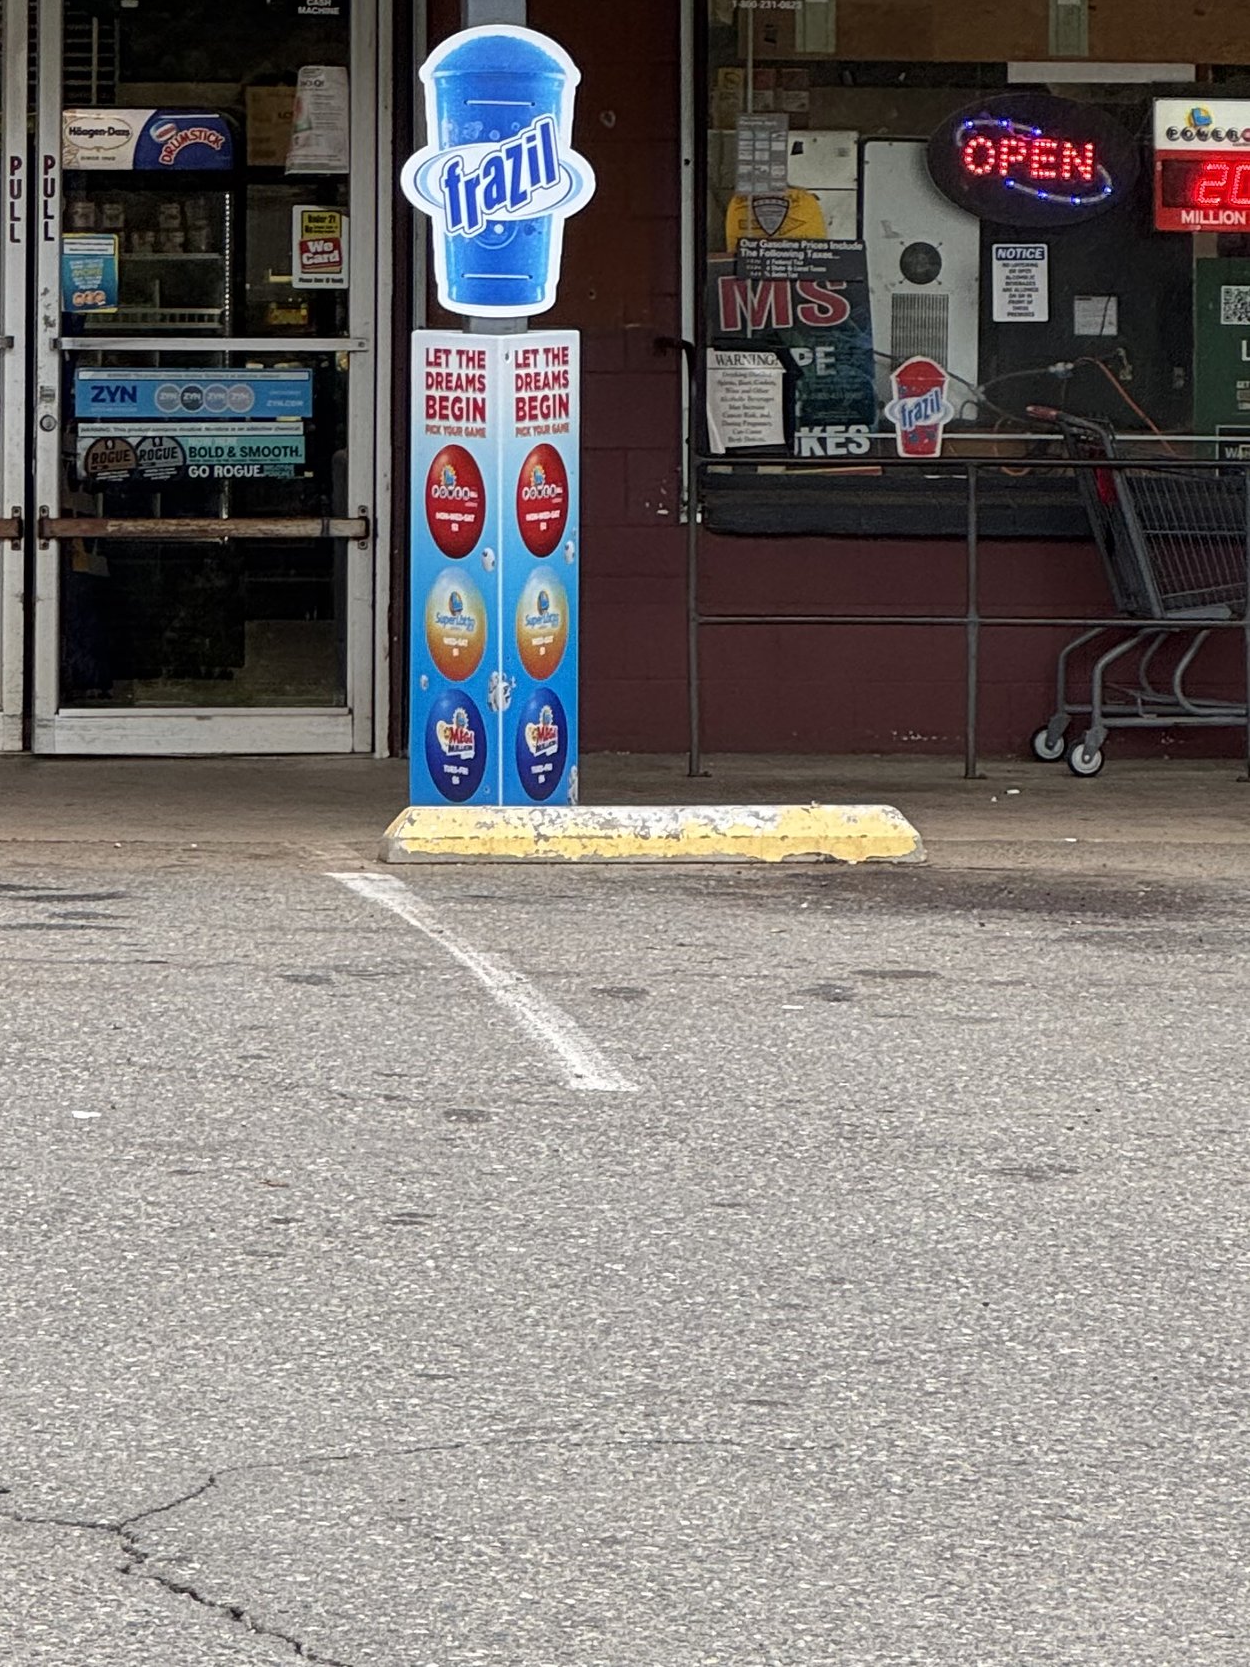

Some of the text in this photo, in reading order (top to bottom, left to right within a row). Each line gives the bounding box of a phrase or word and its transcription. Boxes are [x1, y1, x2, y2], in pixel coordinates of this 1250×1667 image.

[297, 6, 340, 15] MACHINE
[158, 127, 225, 165] DRUMSTICK
[964, 135, 1094, 181] OPEN
[443, 119, 558, 233] frazil
[9, 155, 23, 244] PULL
[42, 154, 56, 242] PULL
[1181, 209, 1246, 225] MILLION
[306, 240, 334, 253] We
[739, 239, 863, 251] Our Gasoline Prices Include
[740, 249, 758, 258] The
[759, 249, 804, 260] Following
[996, 248, 1044, 259] NOTICE
[302, 250, 340, 265] Card
[425, 347, 487, 370] LET THE
[514, 346, 570, 369] LET THE
[425, 371, 487, 393] DREAMS
[514, 369, 570, 393] DREAMS
[90, 385, 137, 403] ZYN
[183, 392, 201, 400] ZYN
[206, 392, 225, 400] ZYN
[425, 394, 487, 423] BEGIN
[515, 393, 570, 422] BEGIN
[901, 389, 941, 428] frazil
[91, 448, 131, 464] ROGUE
[139, 446, 178, 461] ROGUE
[188, 446, 224, 458] BOLD
[227, 446, 236, 458] &
[188, 465, 209, 477] GO
